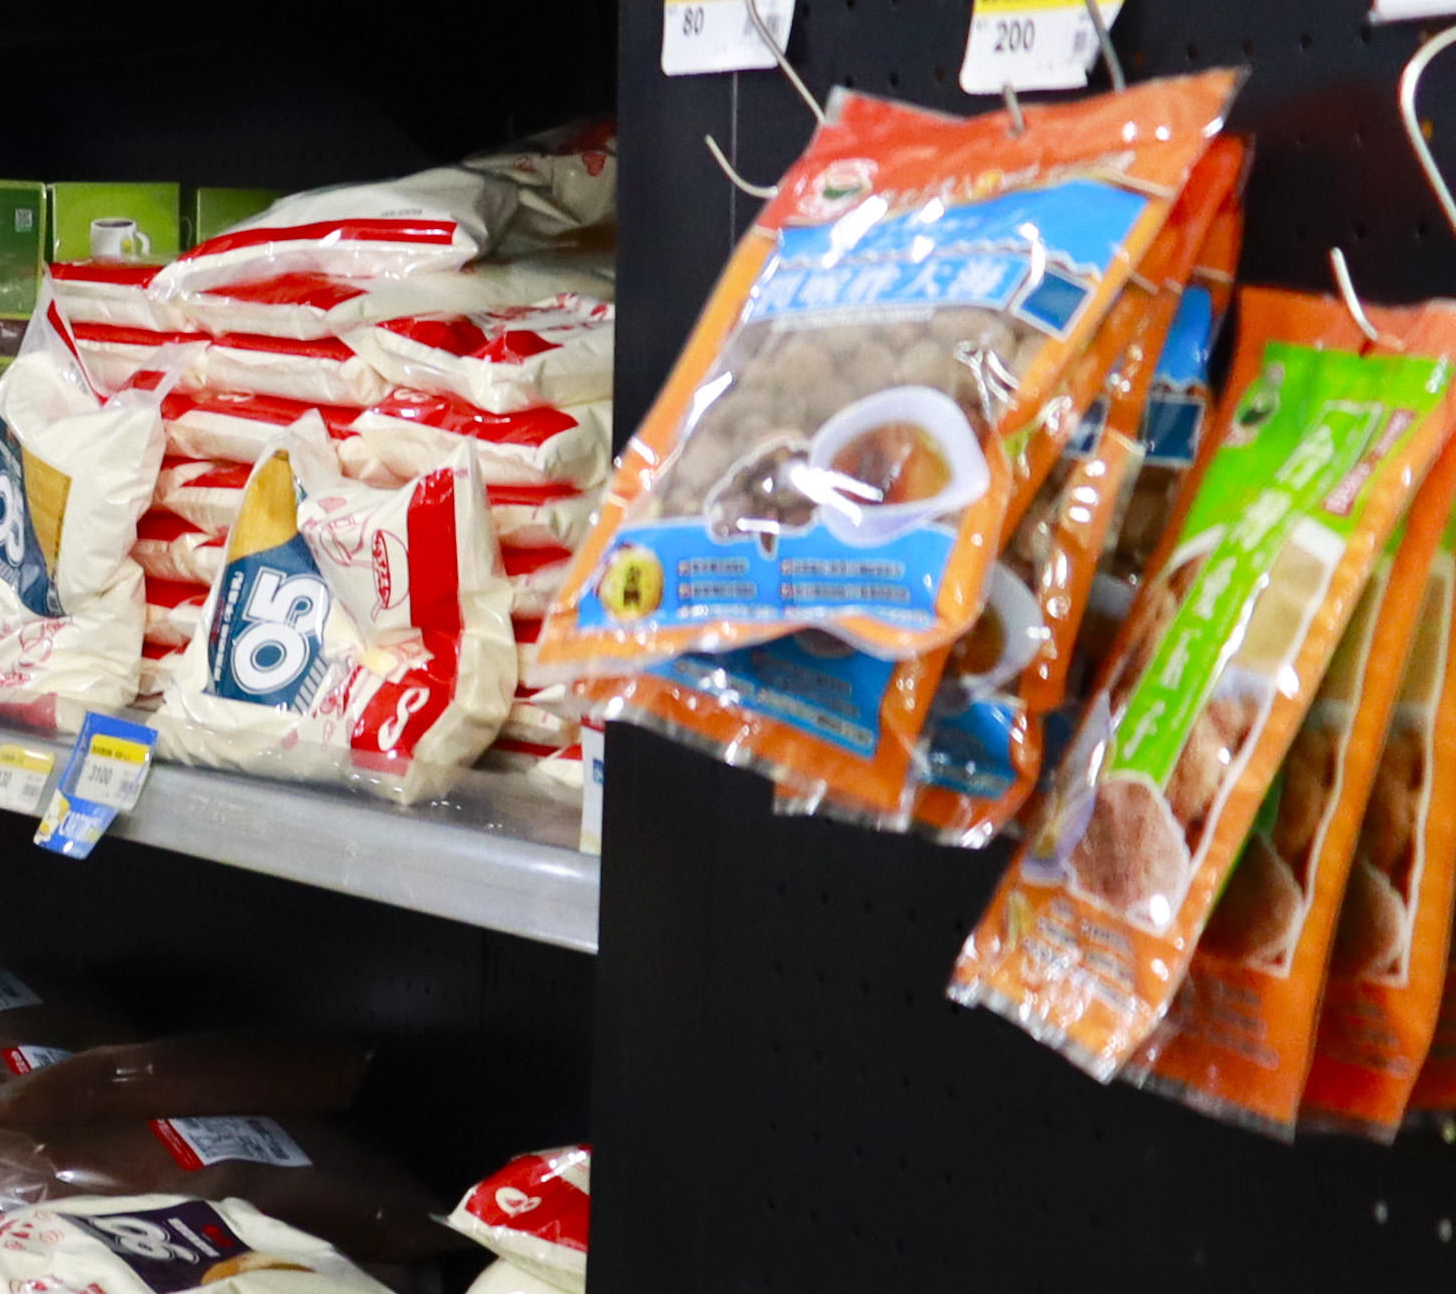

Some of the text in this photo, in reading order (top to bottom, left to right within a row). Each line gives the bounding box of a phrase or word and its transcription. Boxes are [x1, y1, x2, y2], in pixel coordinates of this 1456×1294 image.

[683, 7, 704, 37] 80
[994, 20, 1036, 53] 200
[231, 571, 331, 696] 05
